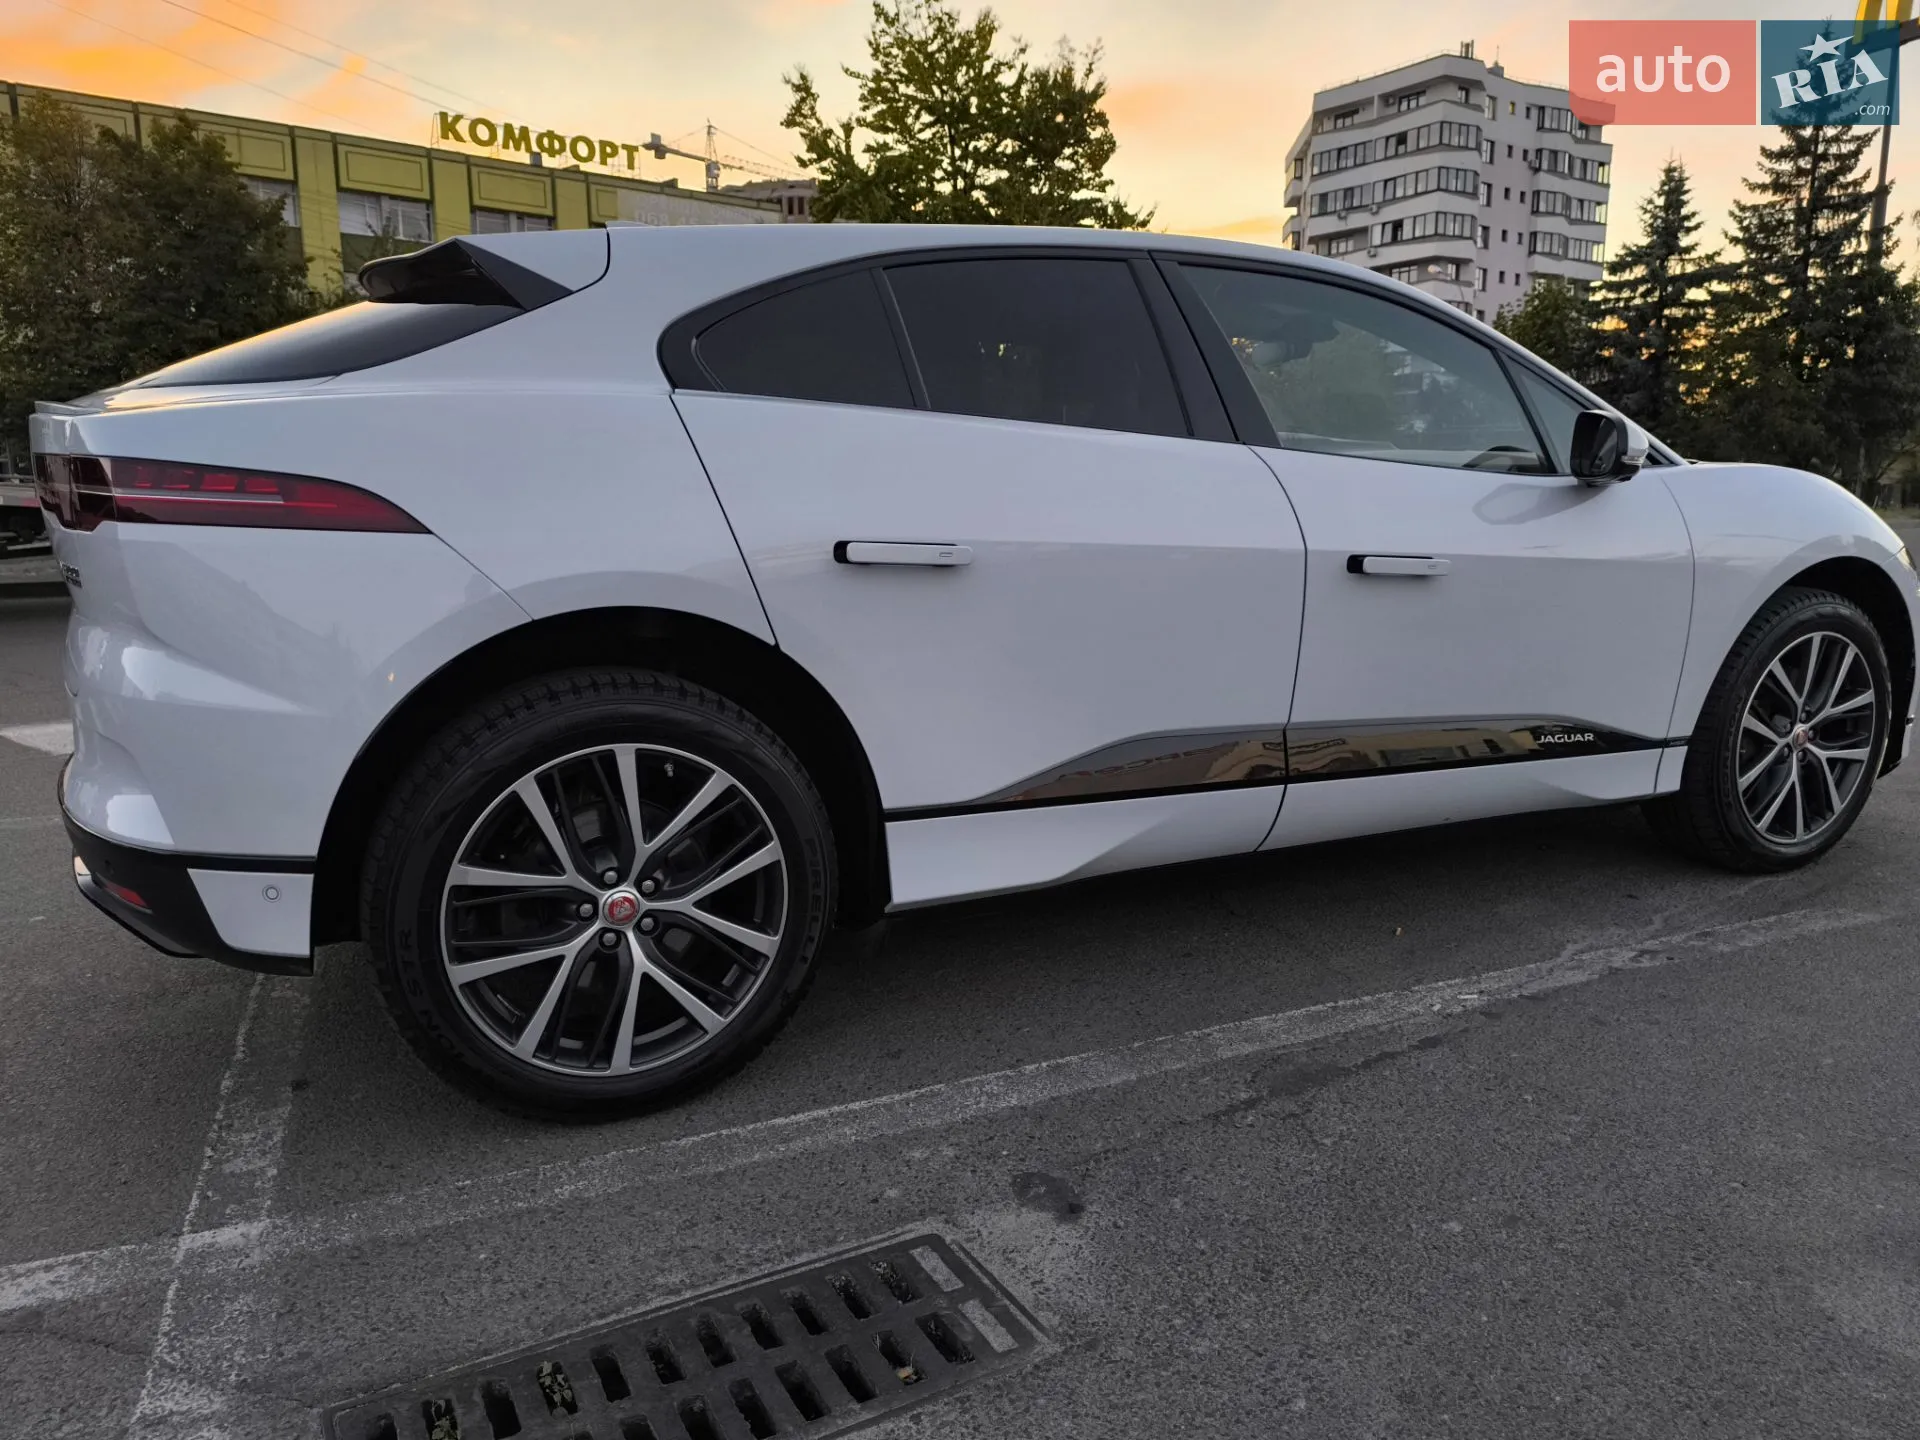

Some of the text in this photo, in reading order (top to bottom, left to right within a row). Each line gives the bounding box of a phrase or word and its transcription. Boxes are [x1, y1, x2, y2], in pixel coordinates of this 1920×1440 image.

[439, 111, 639, 170] КОМФОРТ
[1536, 733, 1594, 743] JAGUAR
[802, 837, 822, 966] PIRELLI
